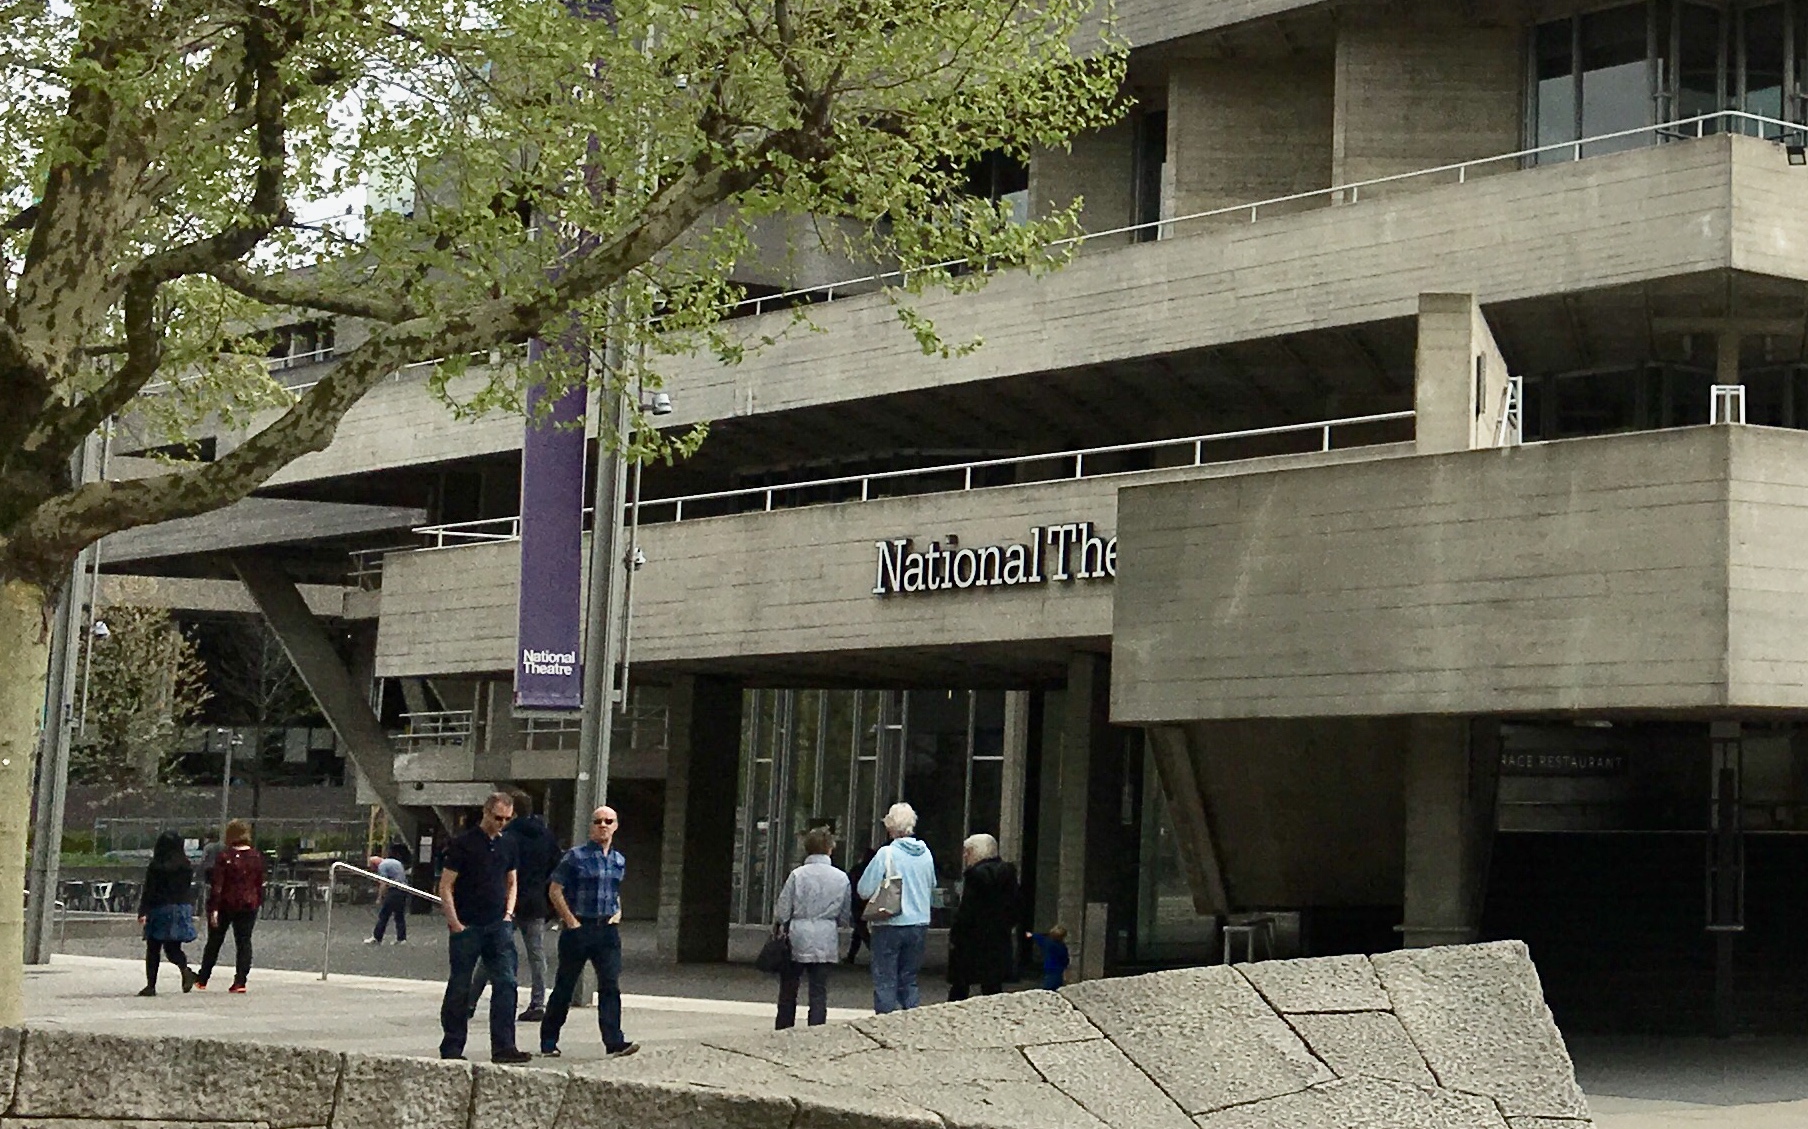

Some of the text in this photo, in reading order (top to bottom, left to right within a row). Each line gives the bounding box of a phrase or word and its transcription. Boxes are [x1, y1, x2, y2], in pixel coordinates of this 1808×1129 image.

[873, 527, 1041, 594] National
[523, 649, 575, 663] National
[523, 661, 572, 675] Theatre
[1538, 755, 1622, 770] RESTAURANT
